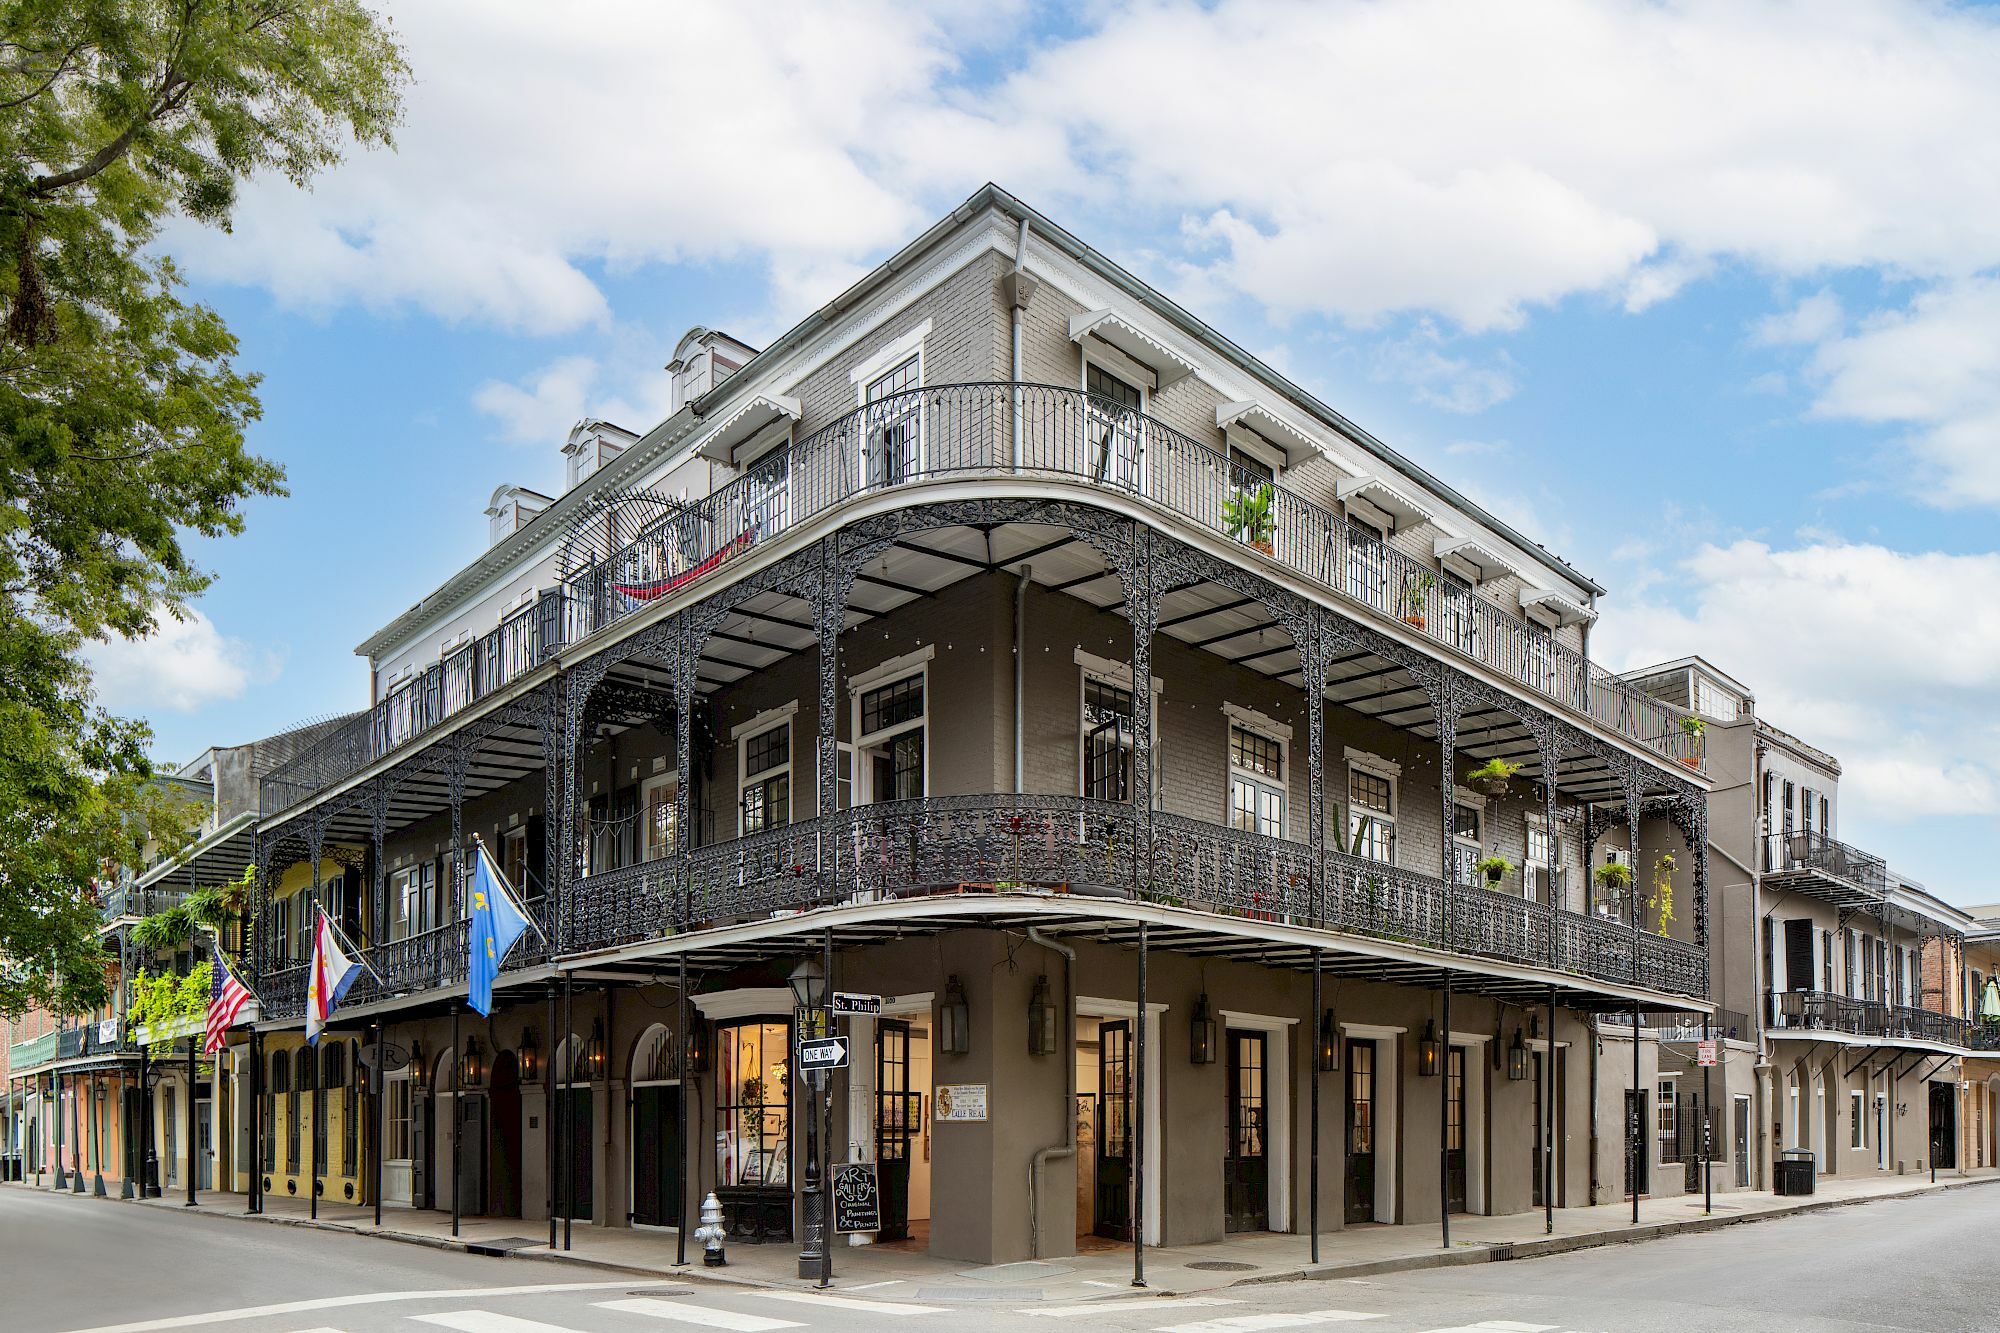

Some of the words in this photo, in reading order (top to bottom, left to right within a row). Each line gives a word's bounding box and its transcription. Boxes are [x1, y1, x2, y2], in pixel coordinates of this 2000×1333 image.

[834, 999, 848, 1010] St.
[851, 1000, 880, 1014] Philip
[805, 1049, 818, 1061] ONE
[820, 1047, 834, 1059] WAY
[840, 1167, 868, 1183] ART
[838, 1181, 871, 1196] GALLERY
[839, 1216, 853, 1228] &
